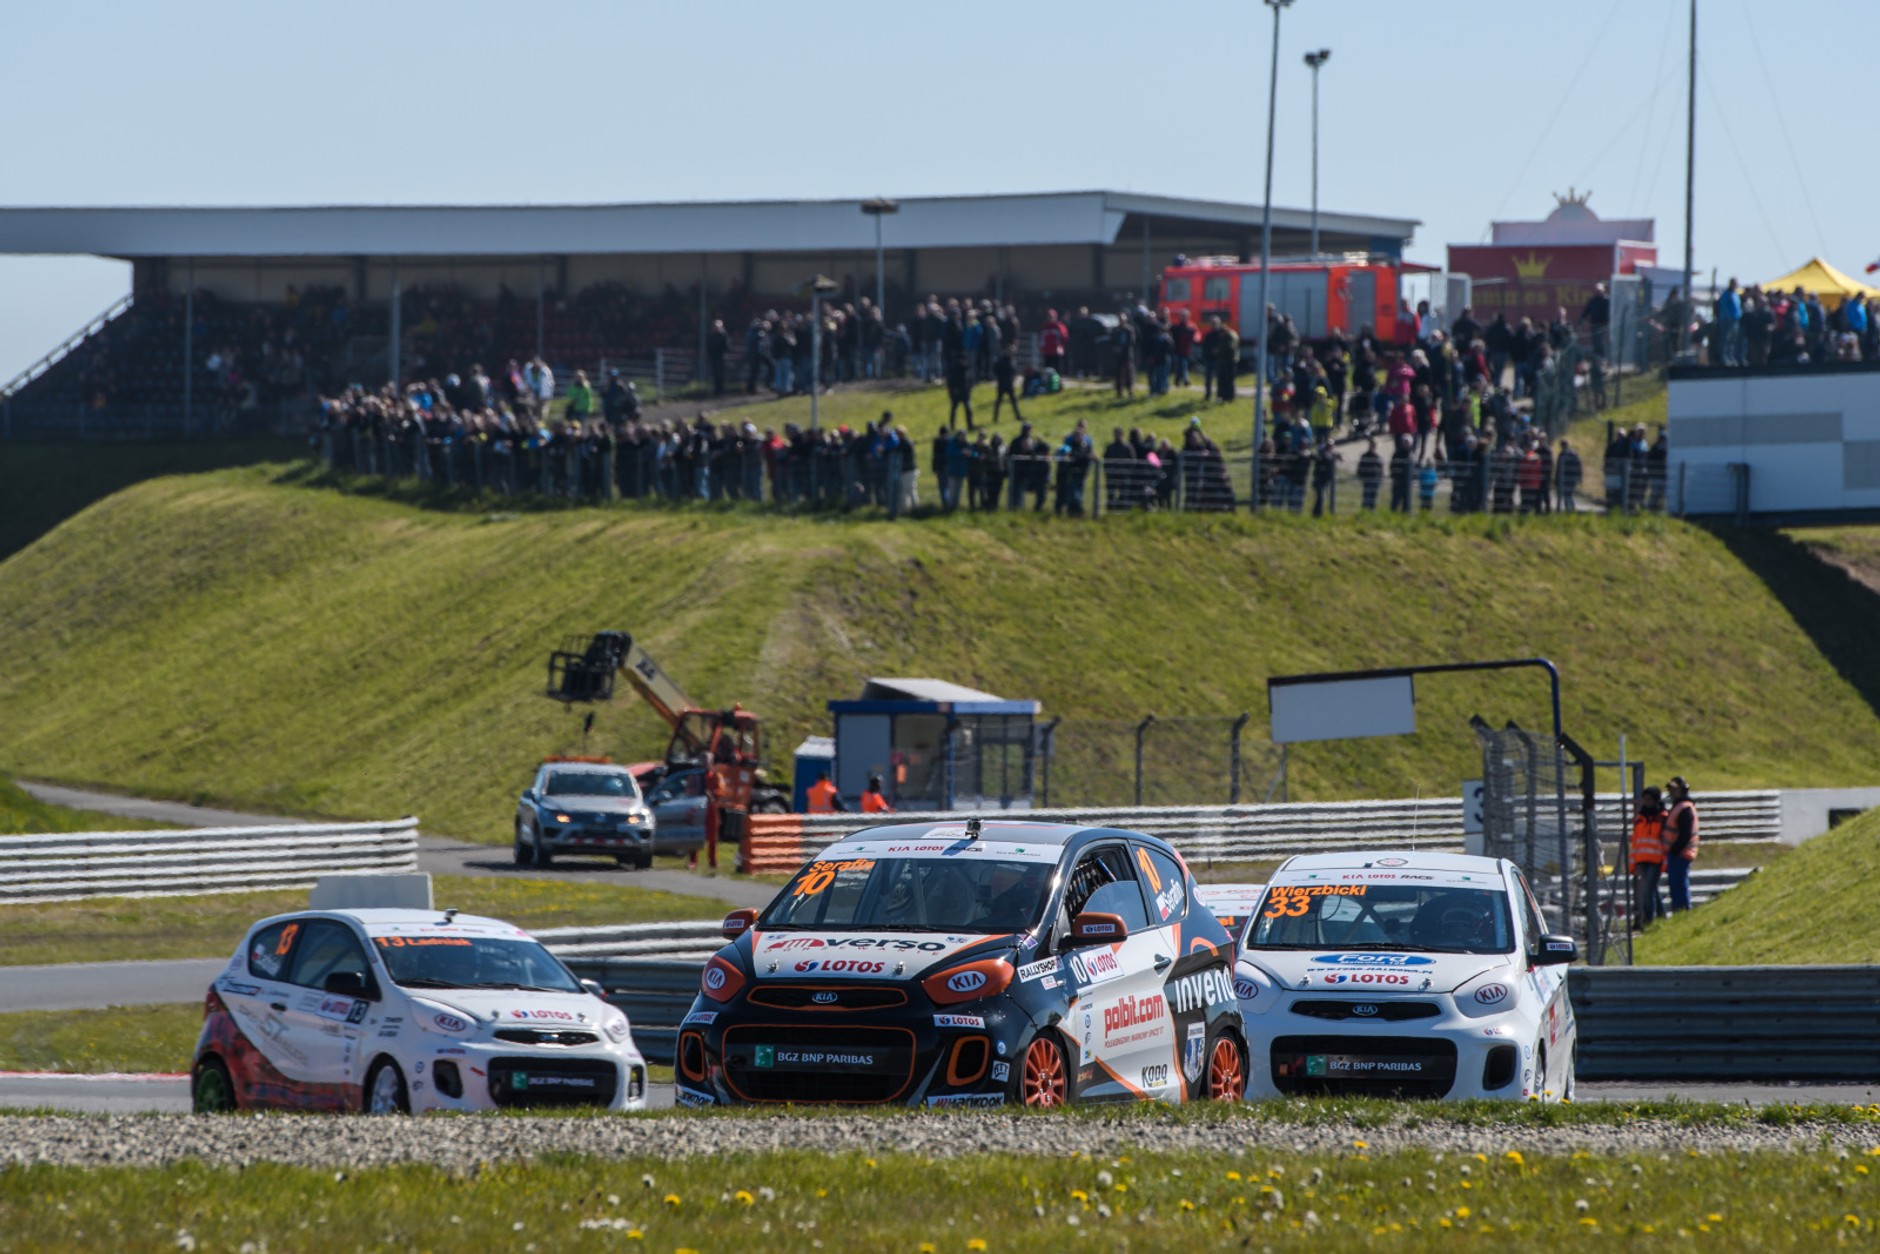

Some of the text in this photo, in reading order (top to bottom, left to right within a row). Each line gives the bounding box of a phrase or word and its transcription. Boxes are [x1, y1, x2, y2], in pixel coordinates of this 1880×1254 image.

[808, 858, 876, 873] Serafin
[1136, 847, 1162, 894] 10
[793, 870, 836, 897] 10
[1264, 895, 1311, 919] 33
[826, 937, 947, 951] verso
[1094, 952, 1118, 973] LOTOS
[1337, 954, 1410, 962] Ford
[820, 960, 887, 974] LOTOS
[1070, 955, 1088, 984] 10
[707, 968, 723, 987] KIA
[951, 973, 983, 990] KIA
[1351, 973, 1409, 985] LOTOS
[1234, 980, 1253, 998] KIA
[1479, 986, 1503, 1002] KIA
[530, 1010, 573, 1020] LOTOS
[1104, 994, 1165, 1039] polbit.com
[1356, 1005, 1374, 1013] KIA
[438, 1016, 460, 1030] KIA
[951, 1016, 980, 1026] LOTOS
[801, 1053, 824, 1063] BNP
[826, 1053, 874, 1065] PARIBAS
[1353, 1061, 1376, 1070] BNP
[1377, 1062, 1422, 1071] PARIBAS
[1141, 1063, 1168, 1087] KODO
